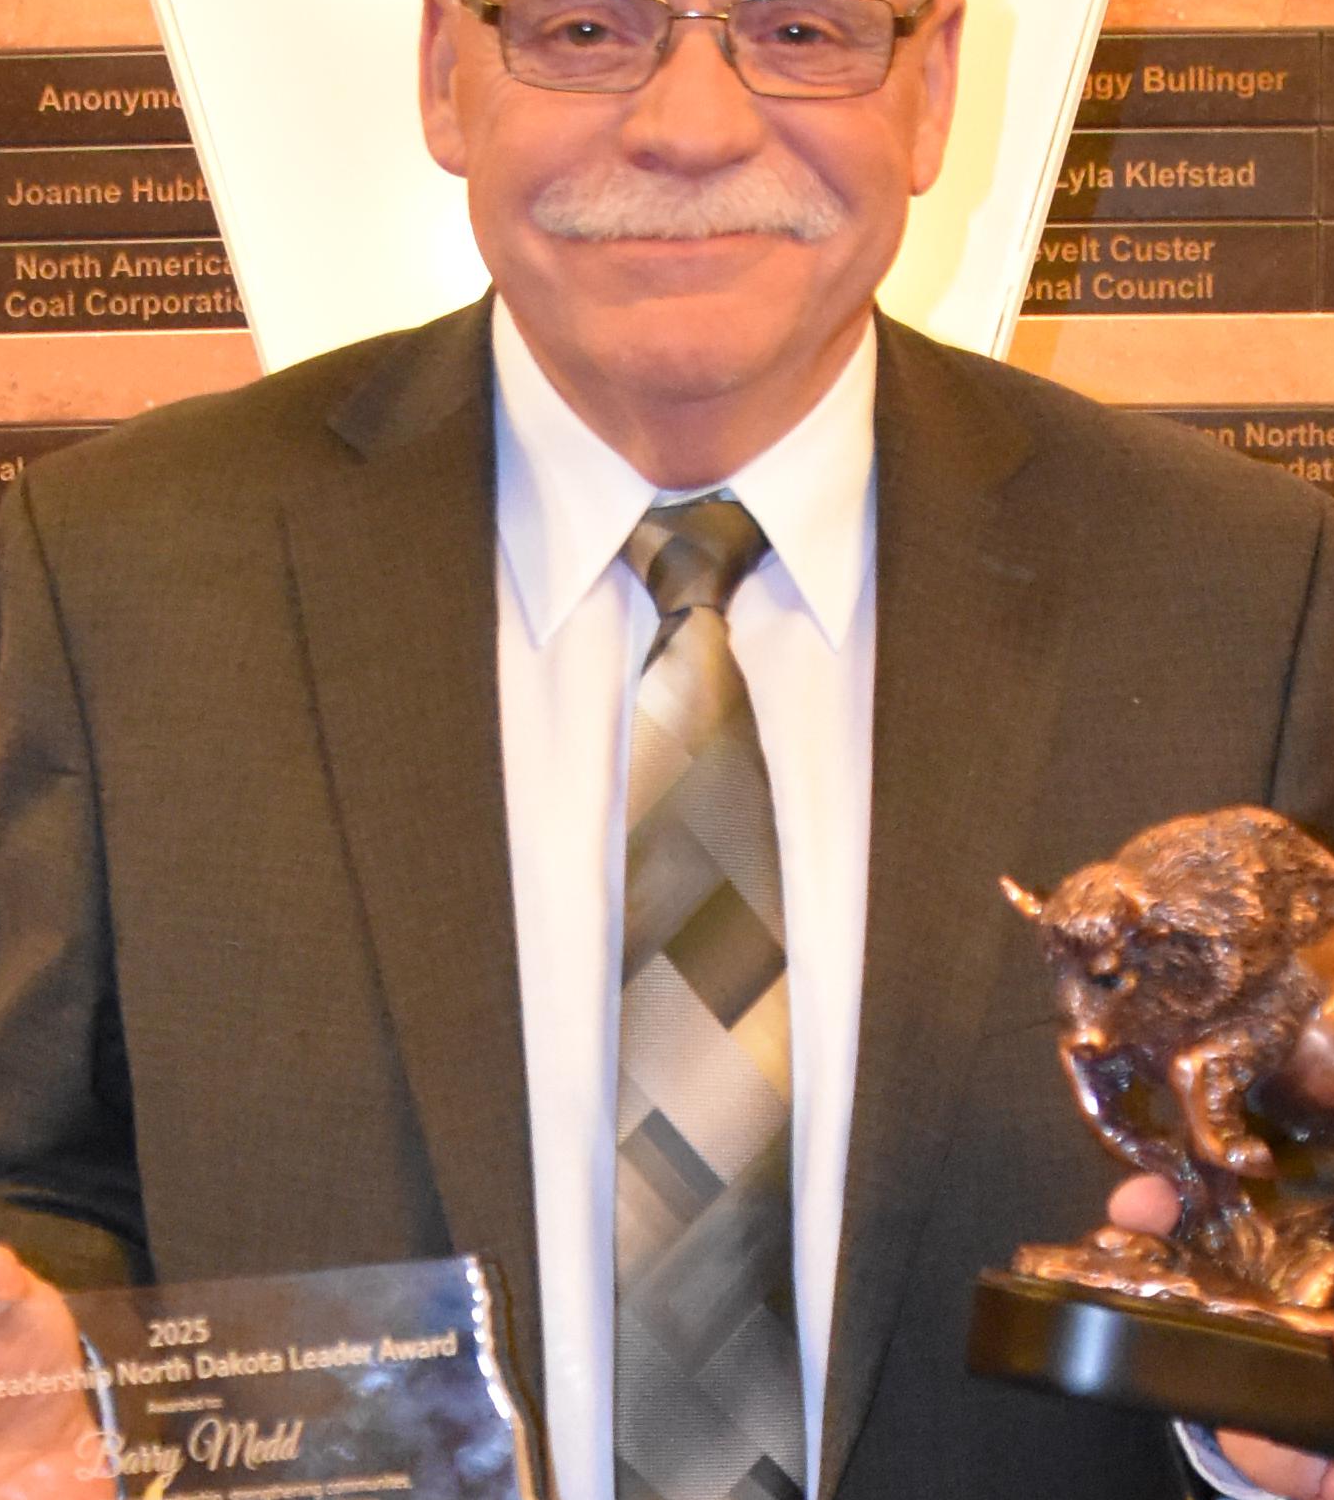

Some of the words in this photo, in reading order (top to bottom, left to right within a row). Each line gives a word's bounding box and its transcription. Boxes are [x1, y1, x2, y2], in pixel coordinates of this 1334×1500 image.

[1143, 65, 1288, 99] Bullinger
[148, 1318, 210, 1349] 2025
[117, 1356, 191, 1387] North
[196, 1349, 285, 1380] Dakota
[289, 1342, 373, 1372] Leader
[378, 1328, 459, 1364] Award
